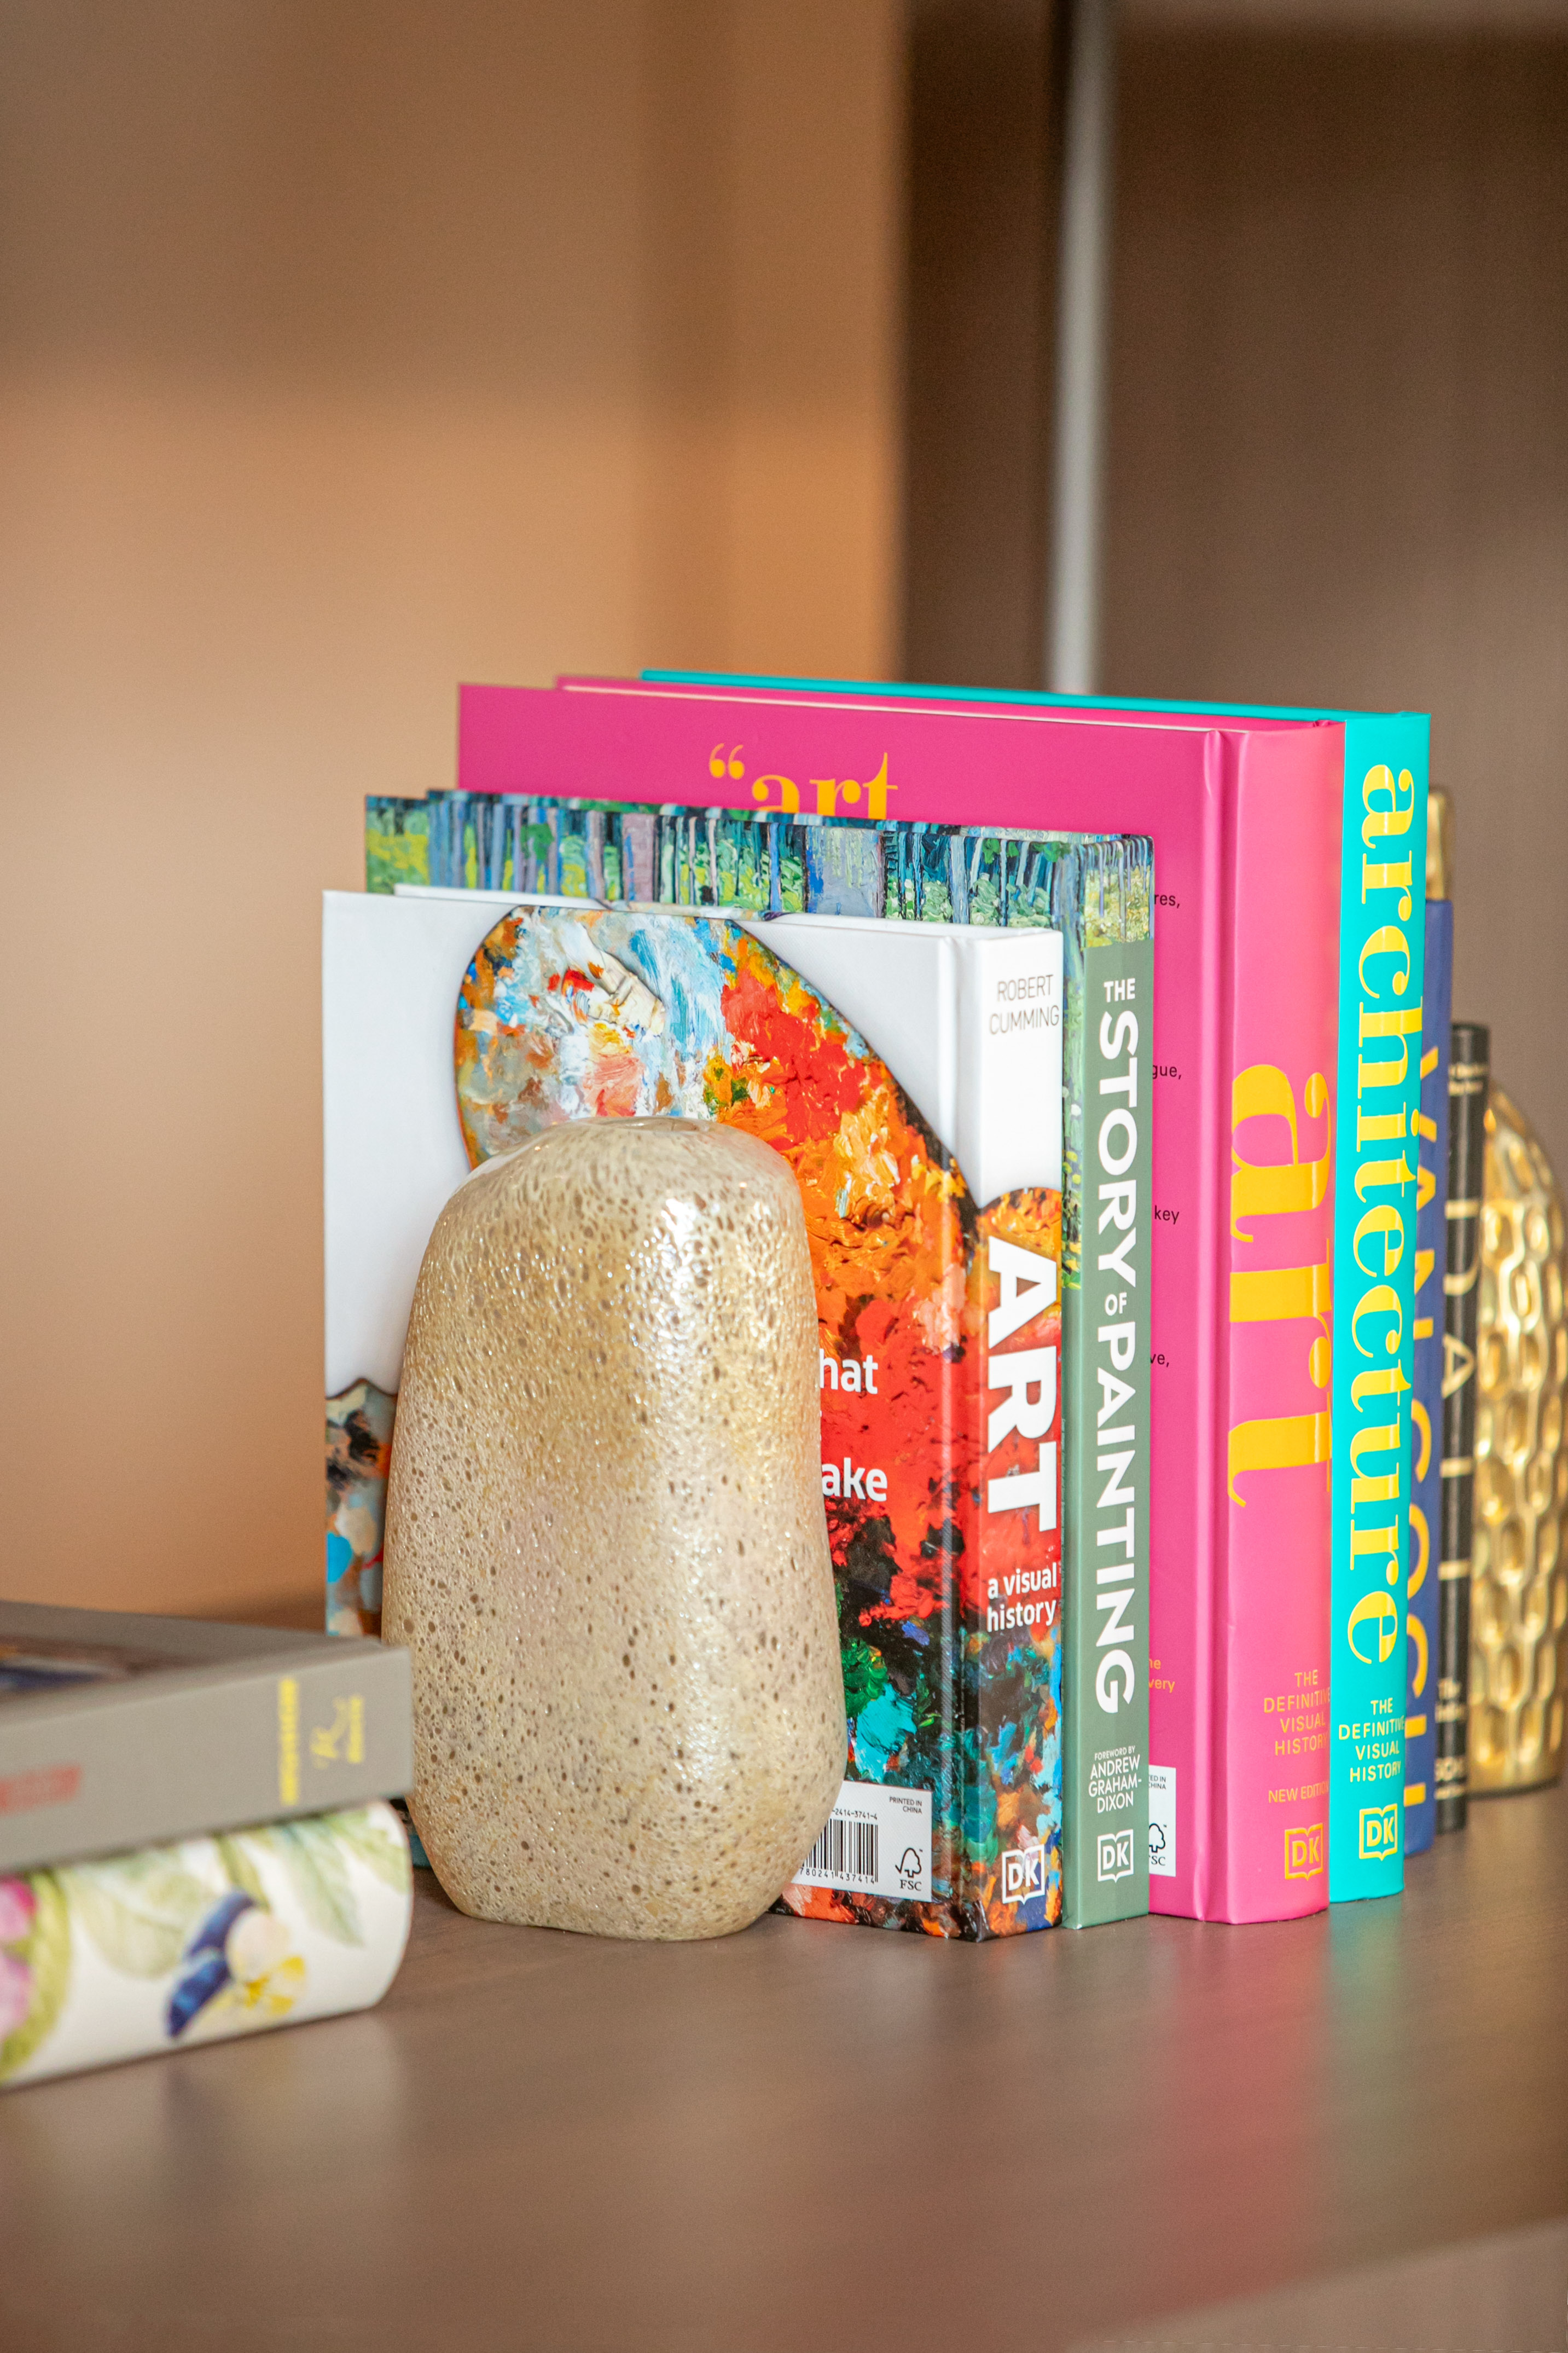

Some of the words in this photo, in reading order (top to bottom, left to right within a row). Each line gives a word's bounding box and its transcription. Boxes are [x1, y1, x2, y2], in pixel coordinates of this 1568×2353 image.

[997, 975, 1054, 1002] ROBERT
[1104, 978, 1136, 1002] THE
[989, 1005, 1059, 1035] CUMMING
[1098, 1010, 1139, 1288] STORY
[1154, 1206, 1180, 1224] key
[1348, 764, 1422, 1664] architecture
[1105, 1292, 1127, 1316] OF
[988, 1236, 1056, 1532] ART
[1096, 1322, 1136, 1713] PAINTING
[988, 1578, 998, 1599] a
[1003, 1562, 1056, 1593] visual
[987, 1599, 1056, 1632] history
[1294, 1670, 1318, 1688] THE
[1370, 1697, 1393, 1716] THE
[1280, 1712, 1325, 1734] VISUAL
[1339, 1715, 1404, 1740] DEFINITIVE
[1095, 1747, 1126, 1761] FOREWORD
[1128, 1745, 1136, 1754] BY
[1275, 1731, 1328, 1756] HISTORY
[1355, 1740, 1399, 1760] VISUAL
[1090, 1754, 1141, 1780] ANDREW
[1350, 1760, 1401, 1783] HISTORY
[1089, 1773, 1142, 1797] GRAHAM-
[1268, 1788, 1298, 1803] NEW
[889, 1796, 914, 1806] PRINTED
[903, 1806, 922, 1814] CHINA
[1097, 1791, 1134, 1814] DIXON
[1367, 1816, 1395, 1847] DK
[1103, 1841, 1129, 1870] DK
[1149, 1855, 1166, 1866] SC
[1292, 1836, 1320, 1867] DK
[899, 1879, 922, 1891] FSC
[1008, 1858, 1039, 1891] DK
